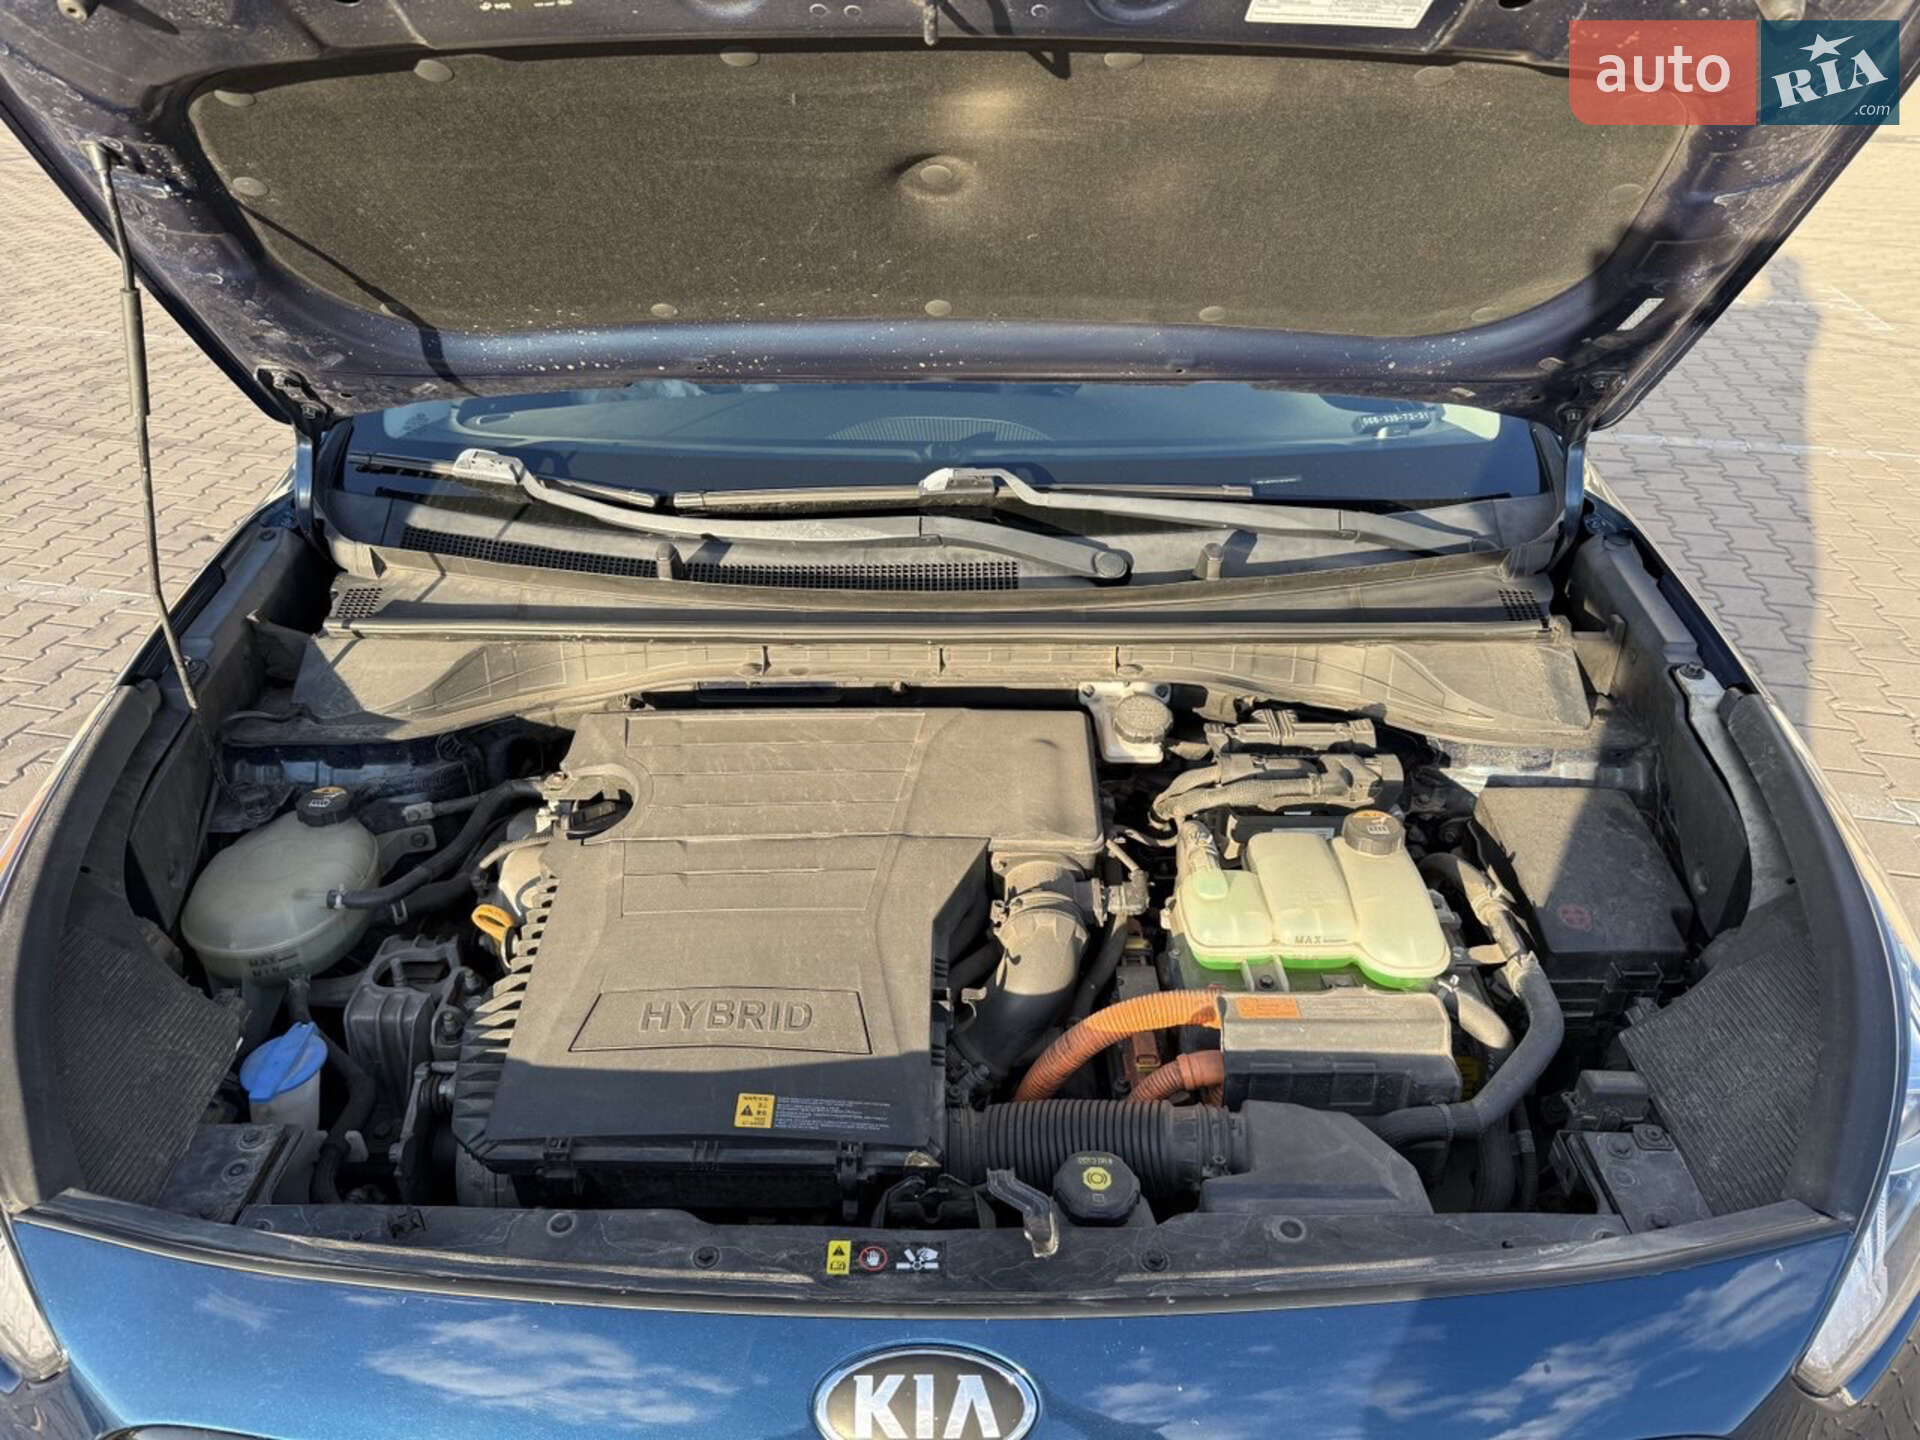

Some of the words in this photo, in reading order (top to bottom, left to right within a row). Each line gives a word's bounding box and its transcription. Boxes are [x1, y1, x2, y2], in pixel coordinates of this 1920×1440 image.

[1295, 935, 1321, 945] MAX
[639, 1000, 814, 1032] HYBRID
[853, 1373, 1001, 1440] KIA
